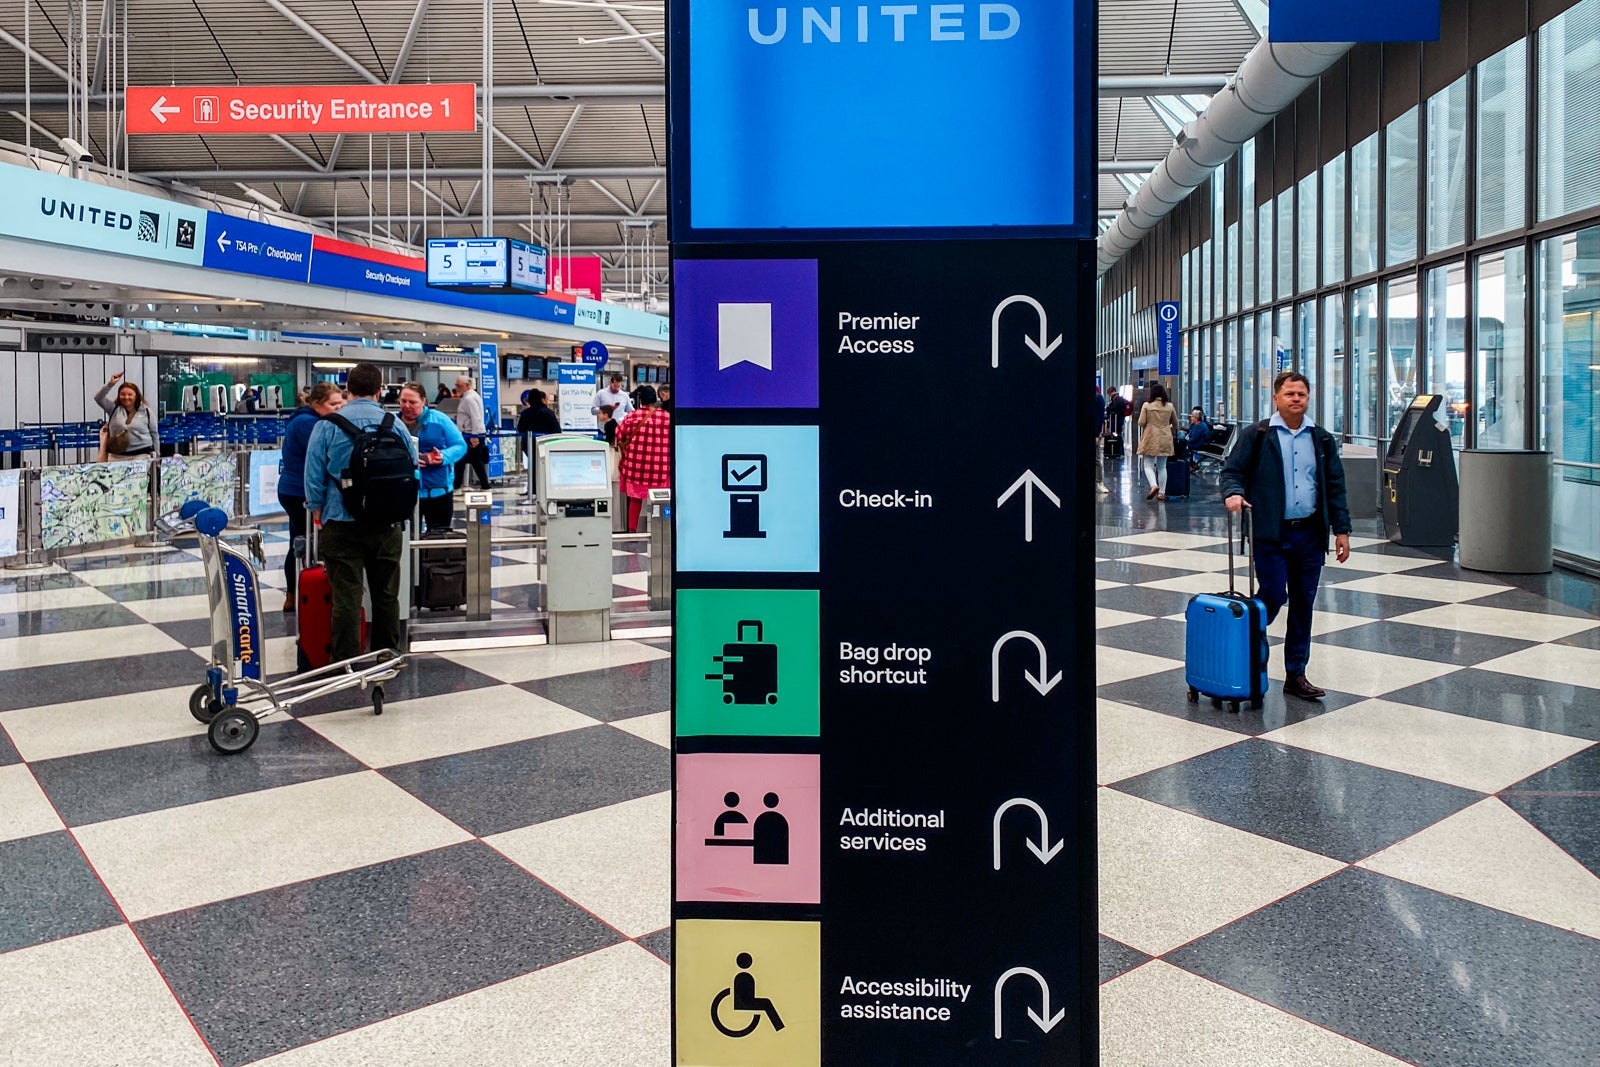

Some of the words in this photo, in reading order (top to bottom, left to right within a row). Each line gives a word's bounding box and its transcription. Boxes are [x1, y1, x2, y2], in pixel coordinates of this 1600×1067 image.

[748, 3, 1021, 45] UNITED
[229, 98, 323, 125] Security
[330, 98, 433, 120] Entrance
[440, 97, 450, 118] 1
[40, 196, 133, 231] UNITED
[235, 239, 247, 253] TSA
[247, 241, 258, 255] Pre
[266, 246, 303, 263] Checkpoint
[443, 254, 452, 269] 5
[518, 256, 524, 272] 5
[365, 269, 385, 283] Security
[385, 272, 411, 287] Checkpoint
[577, 308, 597, 320] UNITED
[837, 311, 920, 331] Premier
[837, 335, 915, 354] Access
[838, 488, 934, 508] Check-in
[839, 642, 880, 665] Bag
[882, 642, 932, 666] drop
[839, 665, 928, 686] shortcut
[839, 807, 946, 829] Additional
[839, 832, 927, 852] services
[839, 975, 972, 1003] Accessibility
[839, 1000, 952, 1022] assistance
